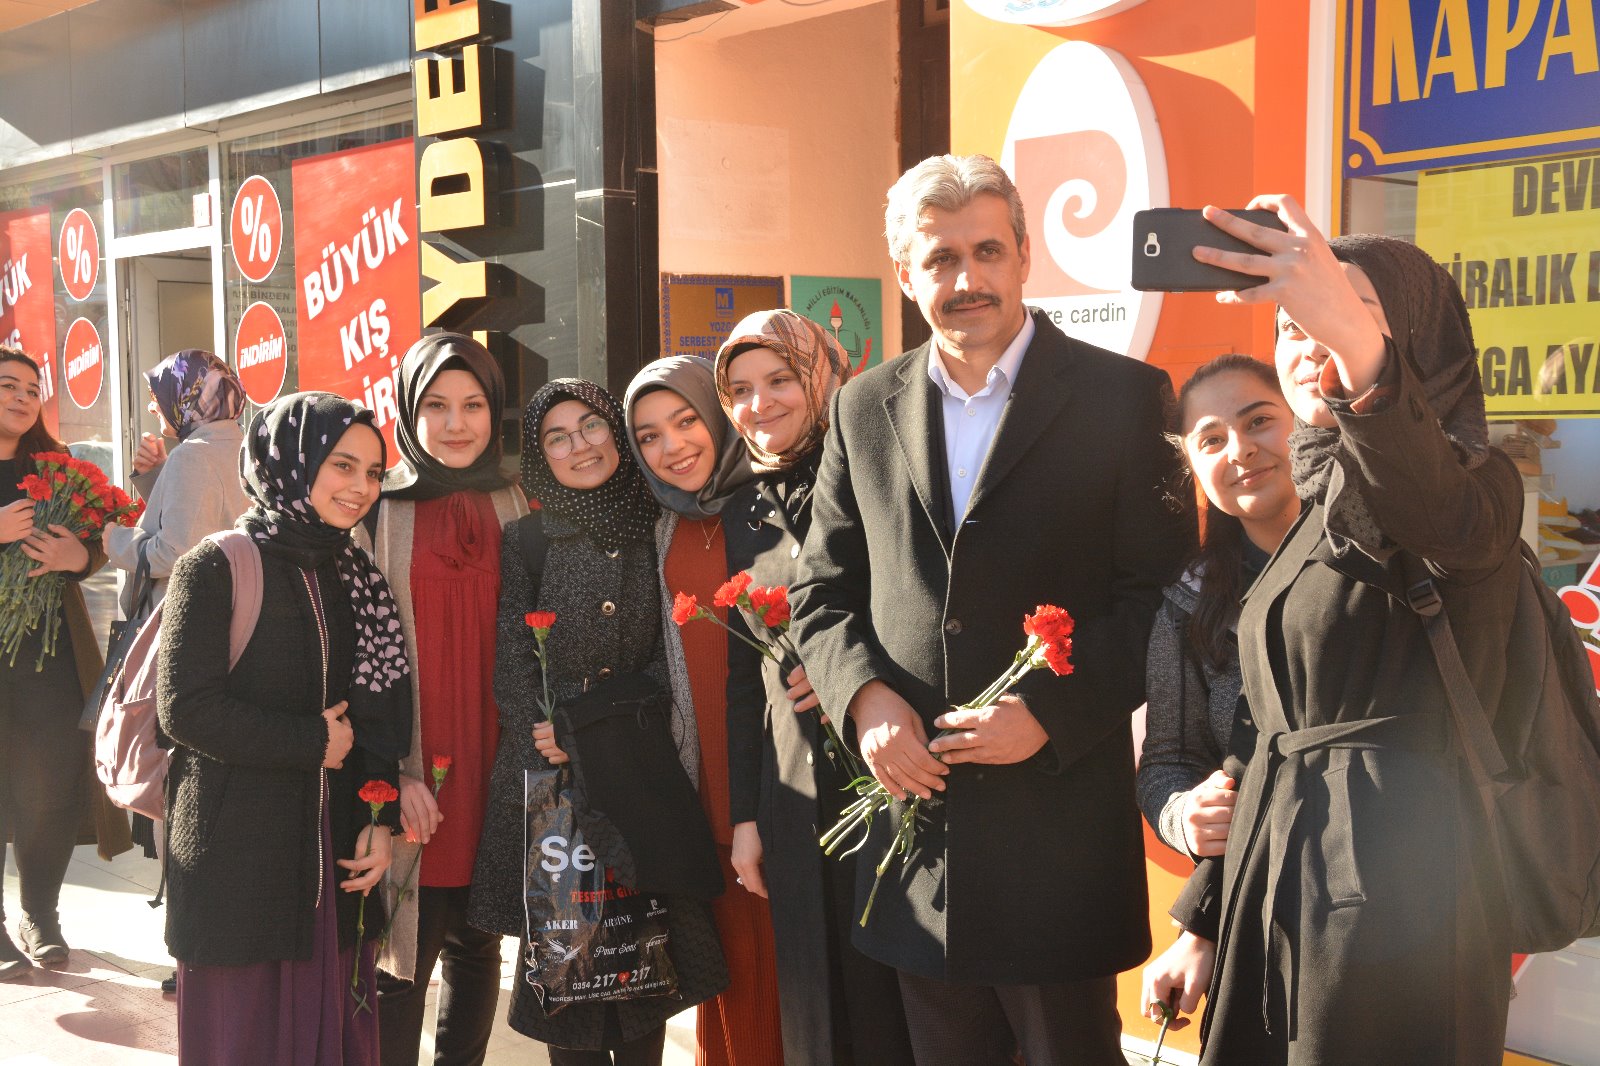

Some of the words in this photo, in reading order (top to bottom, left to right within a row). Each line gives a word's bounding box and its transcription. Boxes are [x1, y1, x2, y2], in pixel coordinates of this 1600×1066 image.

[303, 197, 410, 320] BÜYÜK
[1441, 252, 1578, 310] İRALIK
[340, 298, 391, 371] KIŞ
[1070, 303, 1126, 324] cardin
[680, 336, 716, 347] SERBEST
[1541, 343, 1600, 395] AY
[541, 835, 596, 883] Şe
[544, 919, 579, 930] AKER
[572, 981, 591, 990] 0354
[592, 973, 617, 989] 217
[629, 966, 651, 983] 217
